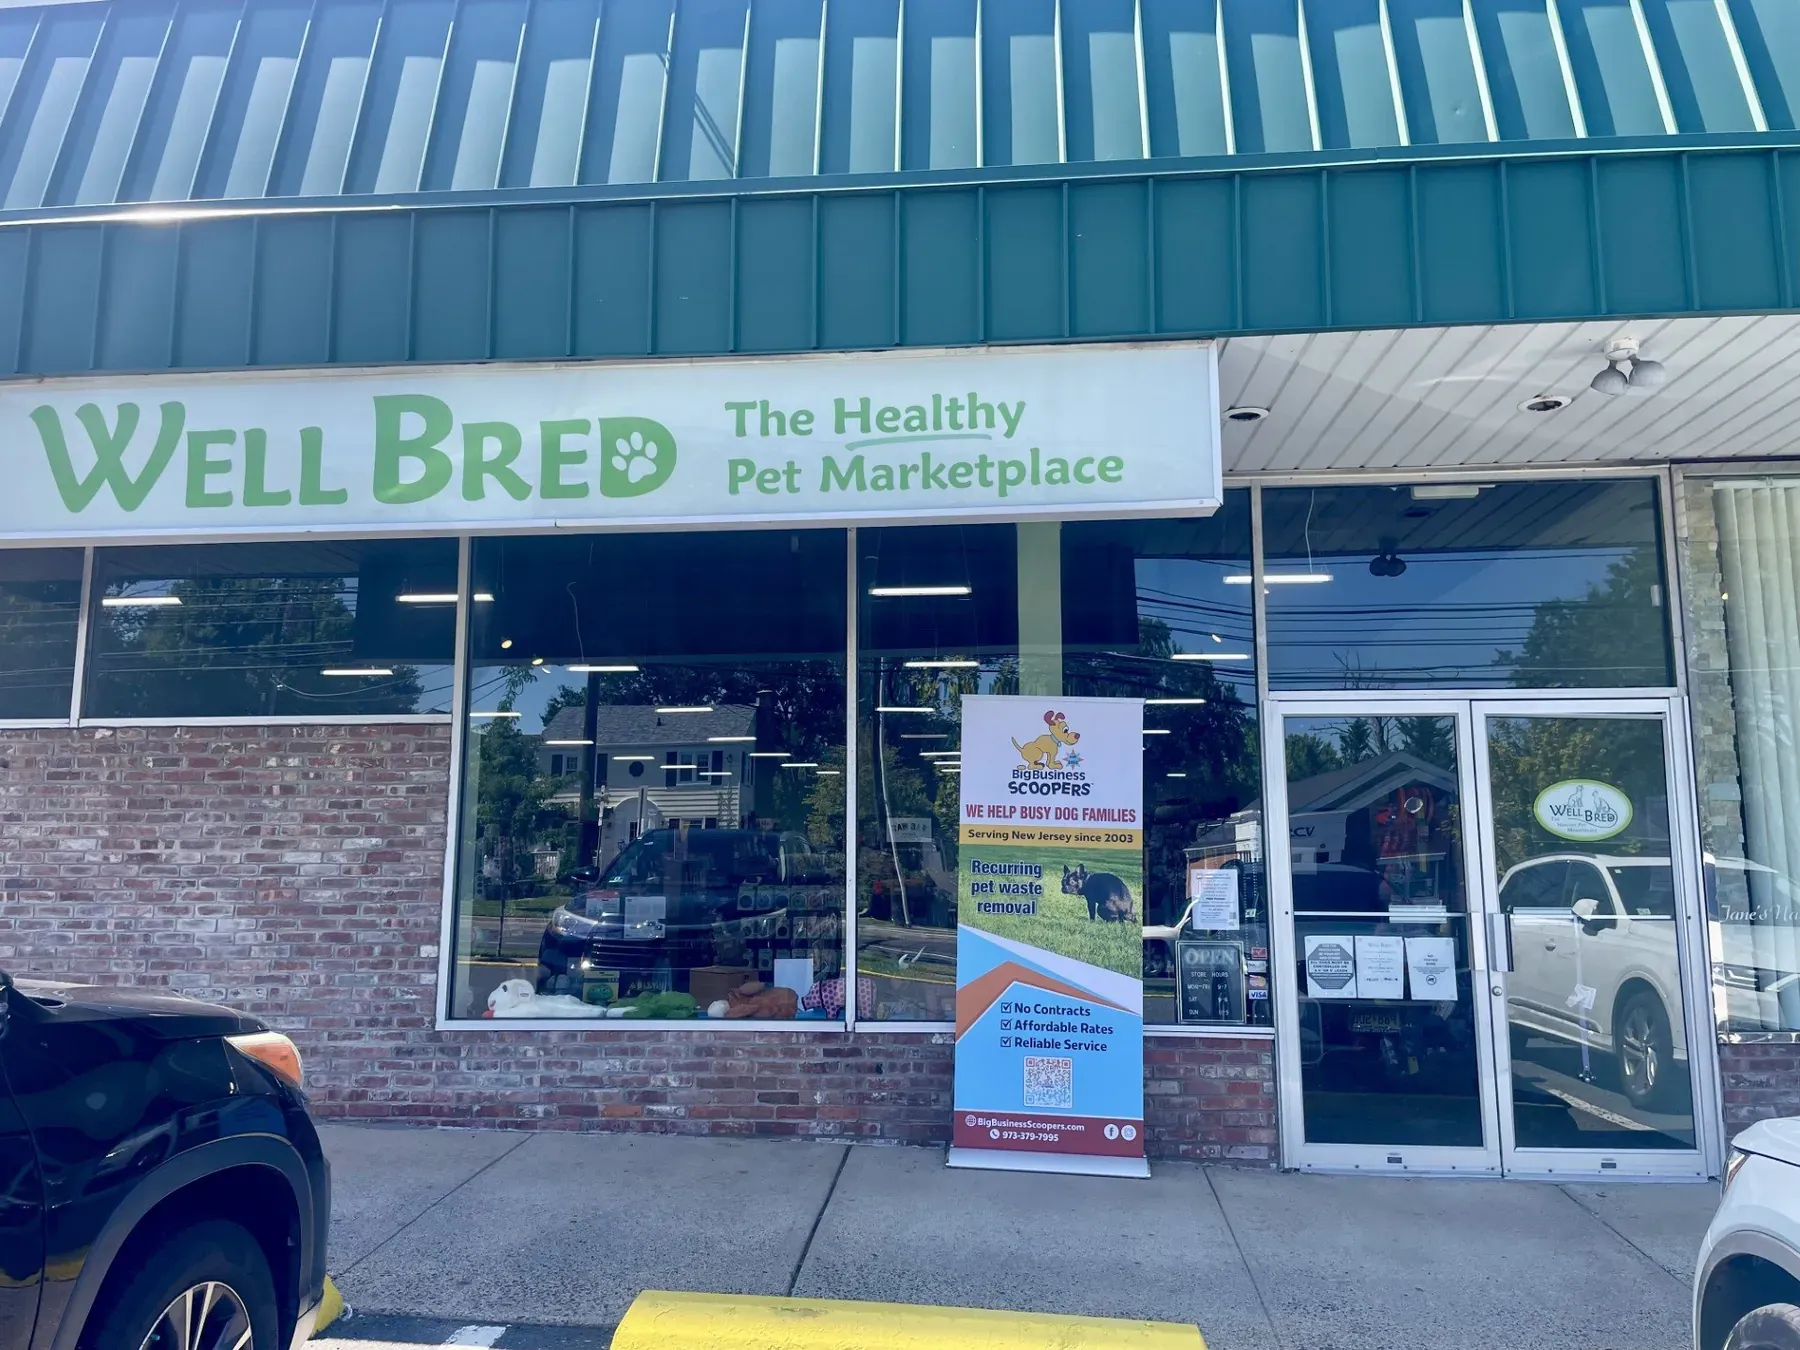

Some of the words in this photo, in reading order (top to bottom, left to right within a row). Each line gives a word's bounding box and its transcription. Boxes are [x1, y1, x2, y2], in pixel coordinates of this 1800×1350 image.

[725, 400, 814, 438] The
[834, 392, 1026, 438] Healthy
[29, 400, 348, 513] WELL
[373, 394, 678, 504] BRED
[728, 458, 802, 496] Pet
[819, 448, 1124, 498] Marketplace
[1008, 781, 1090, 796] SCOOPERS
[966, 804, 983, 817] WE
[988, 805, 1016, 819] HELP
[1020, 806, 1051, 819] BUSY
[1055, 807, 1078, 820] DOG
[1082, 808, 1136, 822] FAMILIES
[968, 829, 1008, 841] Serving
[1012, 831, 1035, 840] New
[1038, 832, 1071, 843] Jersey
[1075, 833, 1101, 842] since
[1105, 834, 1133, 843] 2003
[971, 860, 1042, 878] Recurring
[971, 881, 994, 897] pet
[999, 882, 1043, 895] waste
[977, 900, 1036, 915] removal
[1014, 1003, 1031, 1014] No
[1034, 1004, 1090, 1016] Contracts
[1015, 1020, 1078, 1033] Affordable
[1081, 1023, 1113, 1034] Rates
[1015, 1037, 1061, 1049] Reliable
[1064, 1039, 1107, 1052] Service
[978, 1118, 1084, 1131] BigBusinessScoopers.com
[1003, 1131, 1058, 1141] 973-379-7995
